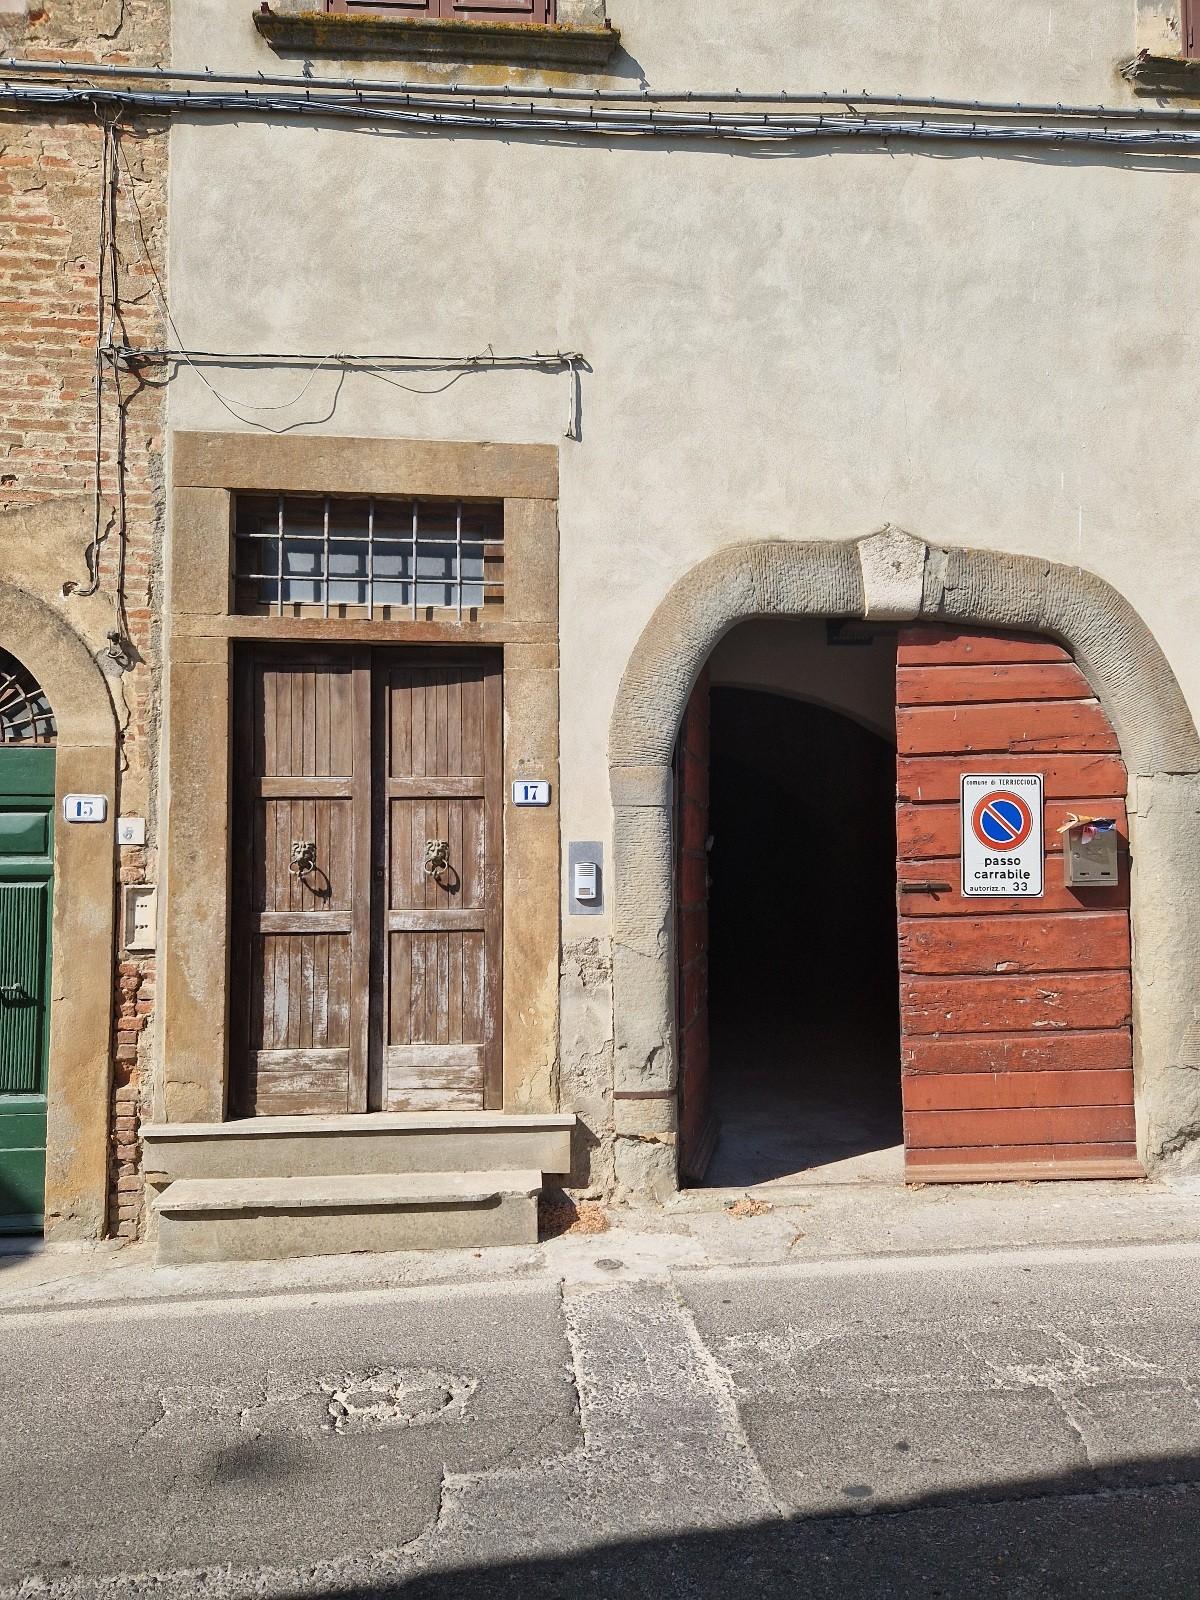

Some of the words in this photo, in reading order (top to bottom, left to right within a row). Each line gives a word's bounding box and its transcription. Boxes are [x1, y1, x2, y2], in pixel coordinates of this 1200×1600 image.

[998, 778, 1038, 786] TERRICCIOLA
[524, 785, 539, 800] 17
[76, 801, 93, 816] 15
[984, 857, 1021, 867] passo
[974, 869, 1031, 879] carrabile
[1012, 881, 1028, 892] 33
